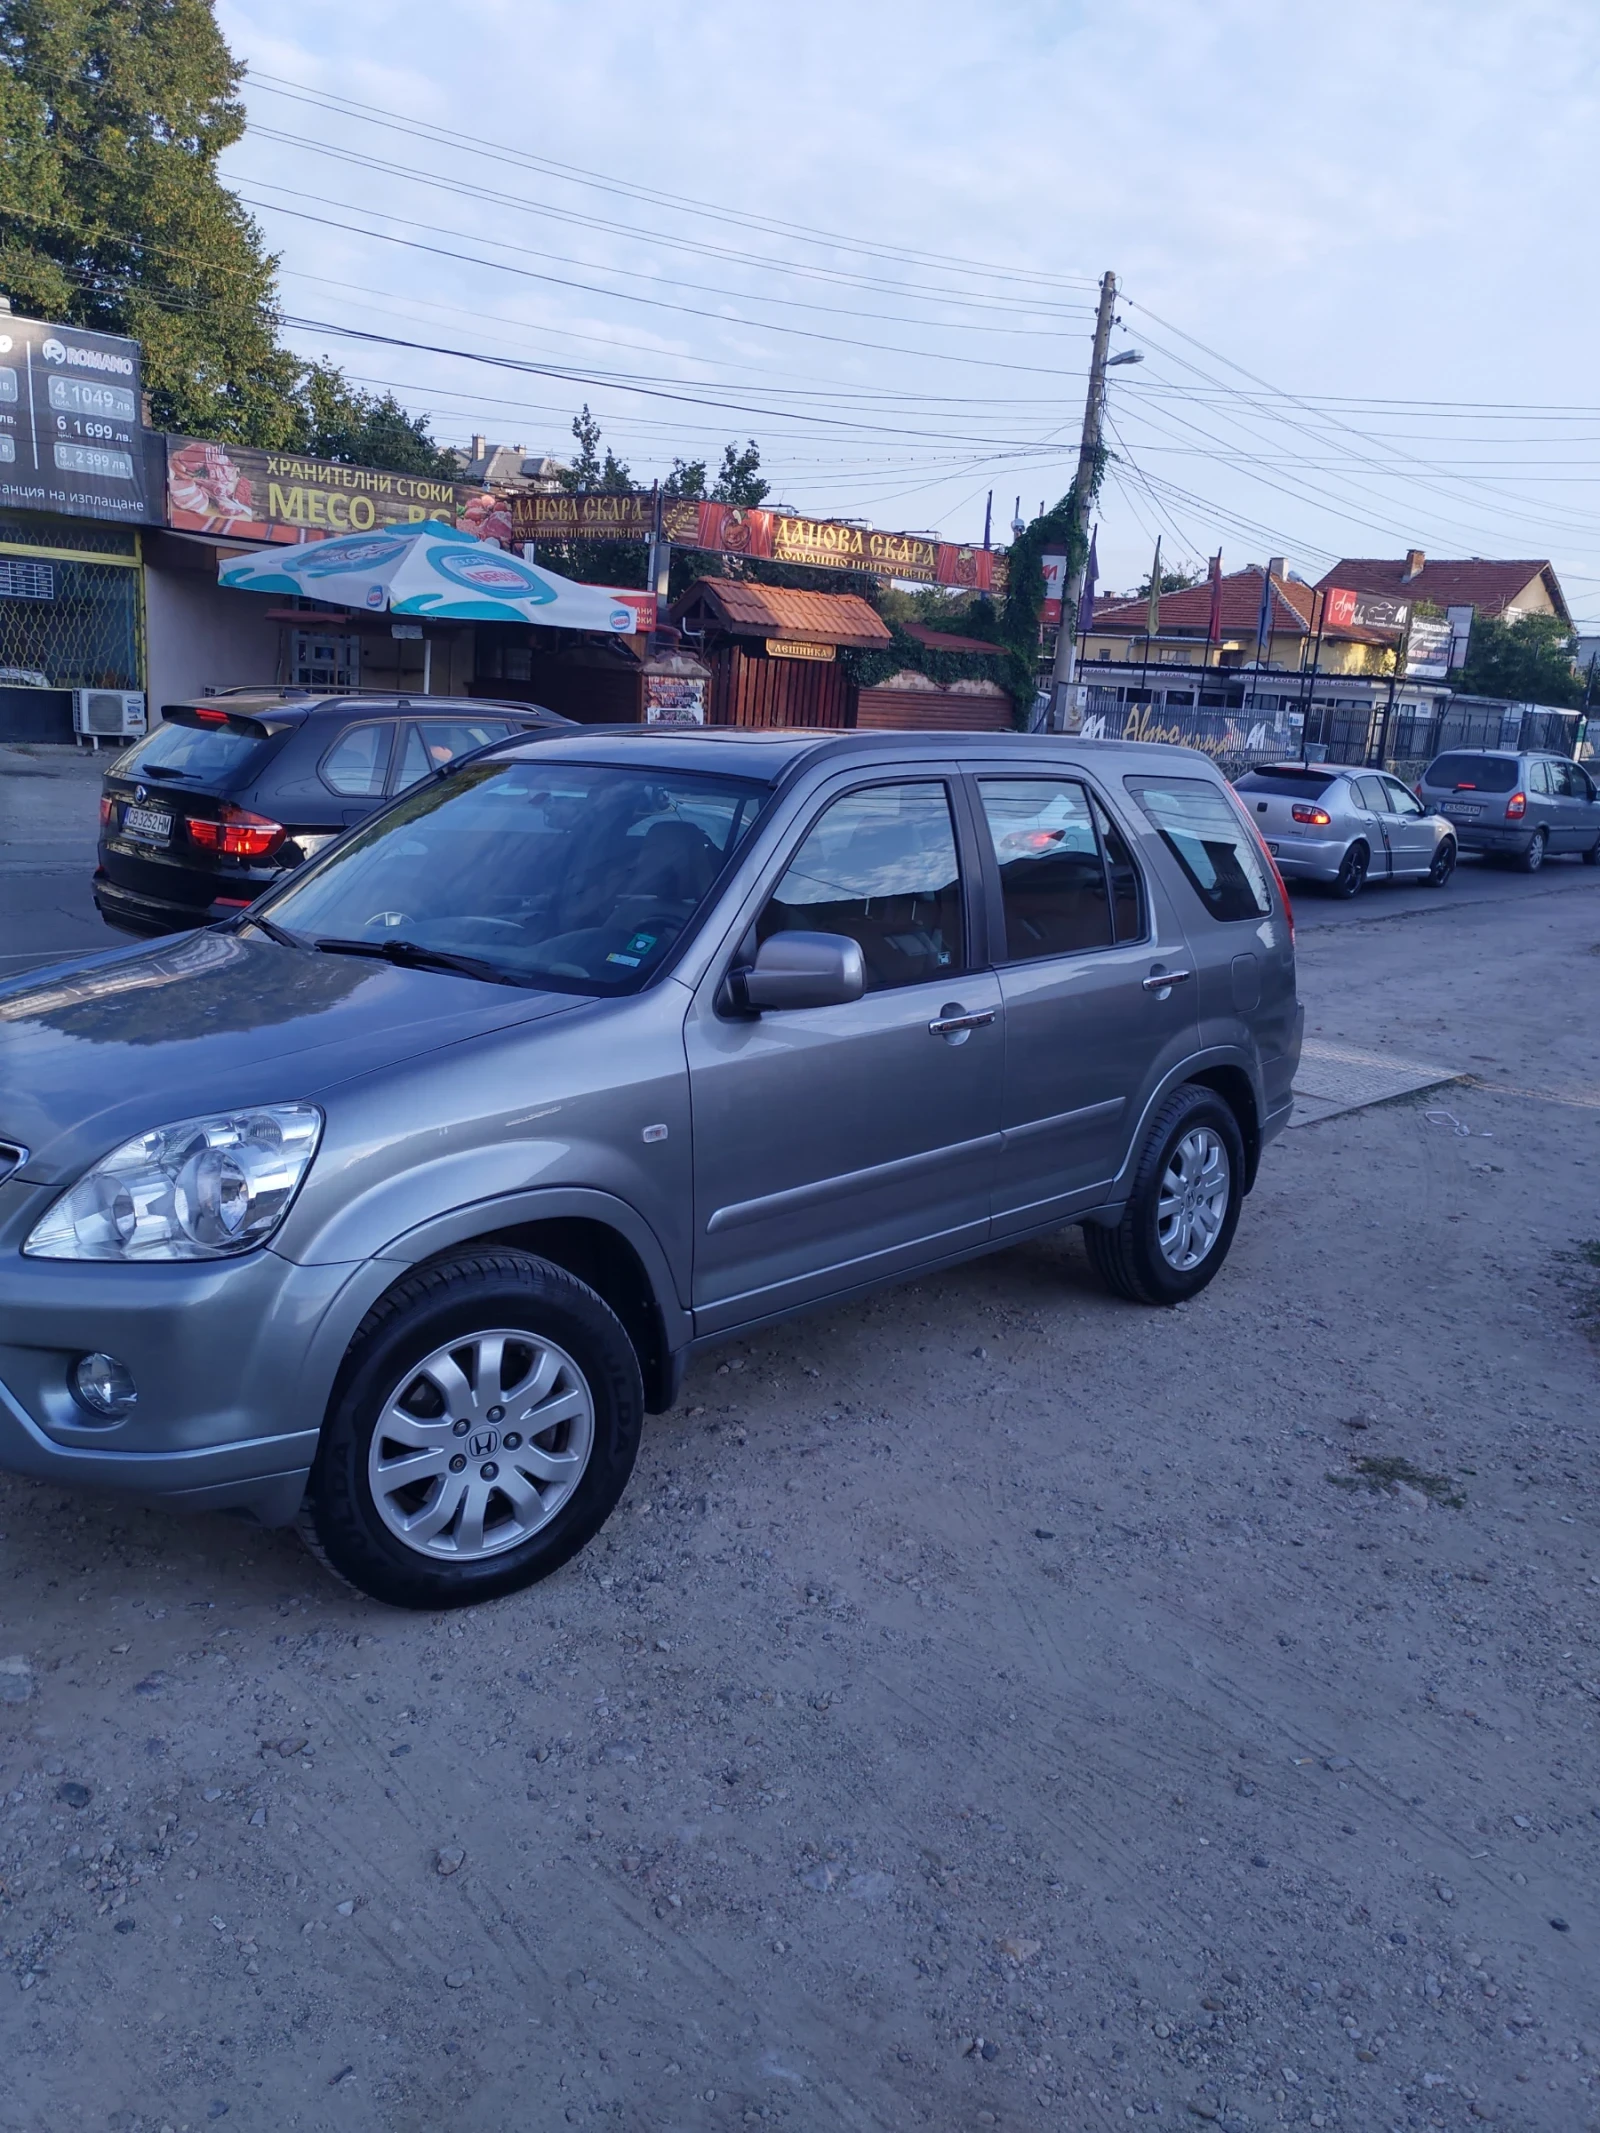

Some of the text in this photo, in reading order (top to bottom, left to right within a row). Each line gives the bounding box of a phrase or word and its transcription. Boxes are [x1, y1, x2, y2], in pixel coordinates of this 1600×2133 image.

[66, 348, 133, 375] ROMANO
[54, 381, 67, 399] 4
[116, 403, 133, 412] лв.
[56, 415, 67, 430] 6
[115, 432, 133, 443] лв.
[59, 446, 67, 459] 8
[112, 459, 129, 471] лв.
[266, 455, 453, 504] ХРАНИТЕЛНИ СТОКИ
[0, 484, 144, 512] анция на изплащане
[268, 482, 375, 531] МЕСО
[512, 497, 643, 525] ДАНОВА СКАРА
[774, 517, 935, 566] ДАНОВА СКАРА
